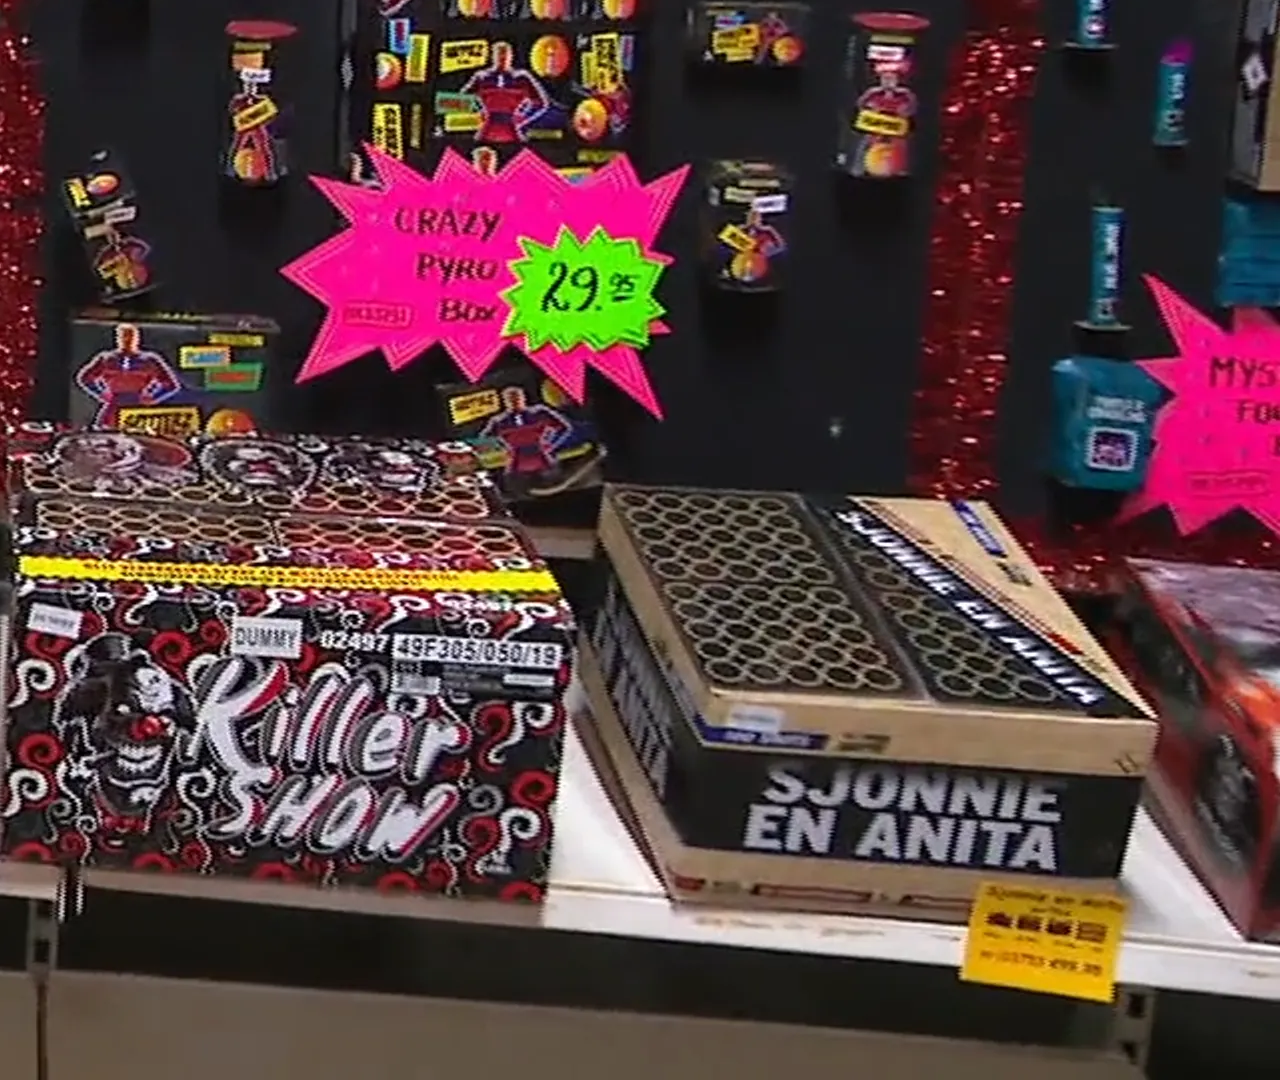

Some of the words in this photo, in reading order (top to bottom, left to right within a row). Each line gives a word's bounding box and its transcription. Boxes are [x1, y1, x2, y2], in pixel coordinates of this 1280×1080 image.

[393, 205, 502, 243] CRAZY
[415, 252, 499, 287] PYRO
[833, 509, 957, 597] SJONNIE
[235, 625, 300, 649] DUMMY
[184, 654, 471, 787] Killer
[762, 762, 1063, 823] SJONNIE
[742, 802, 841, 855] EN
[854, 816, 1059, 874] ANITA
